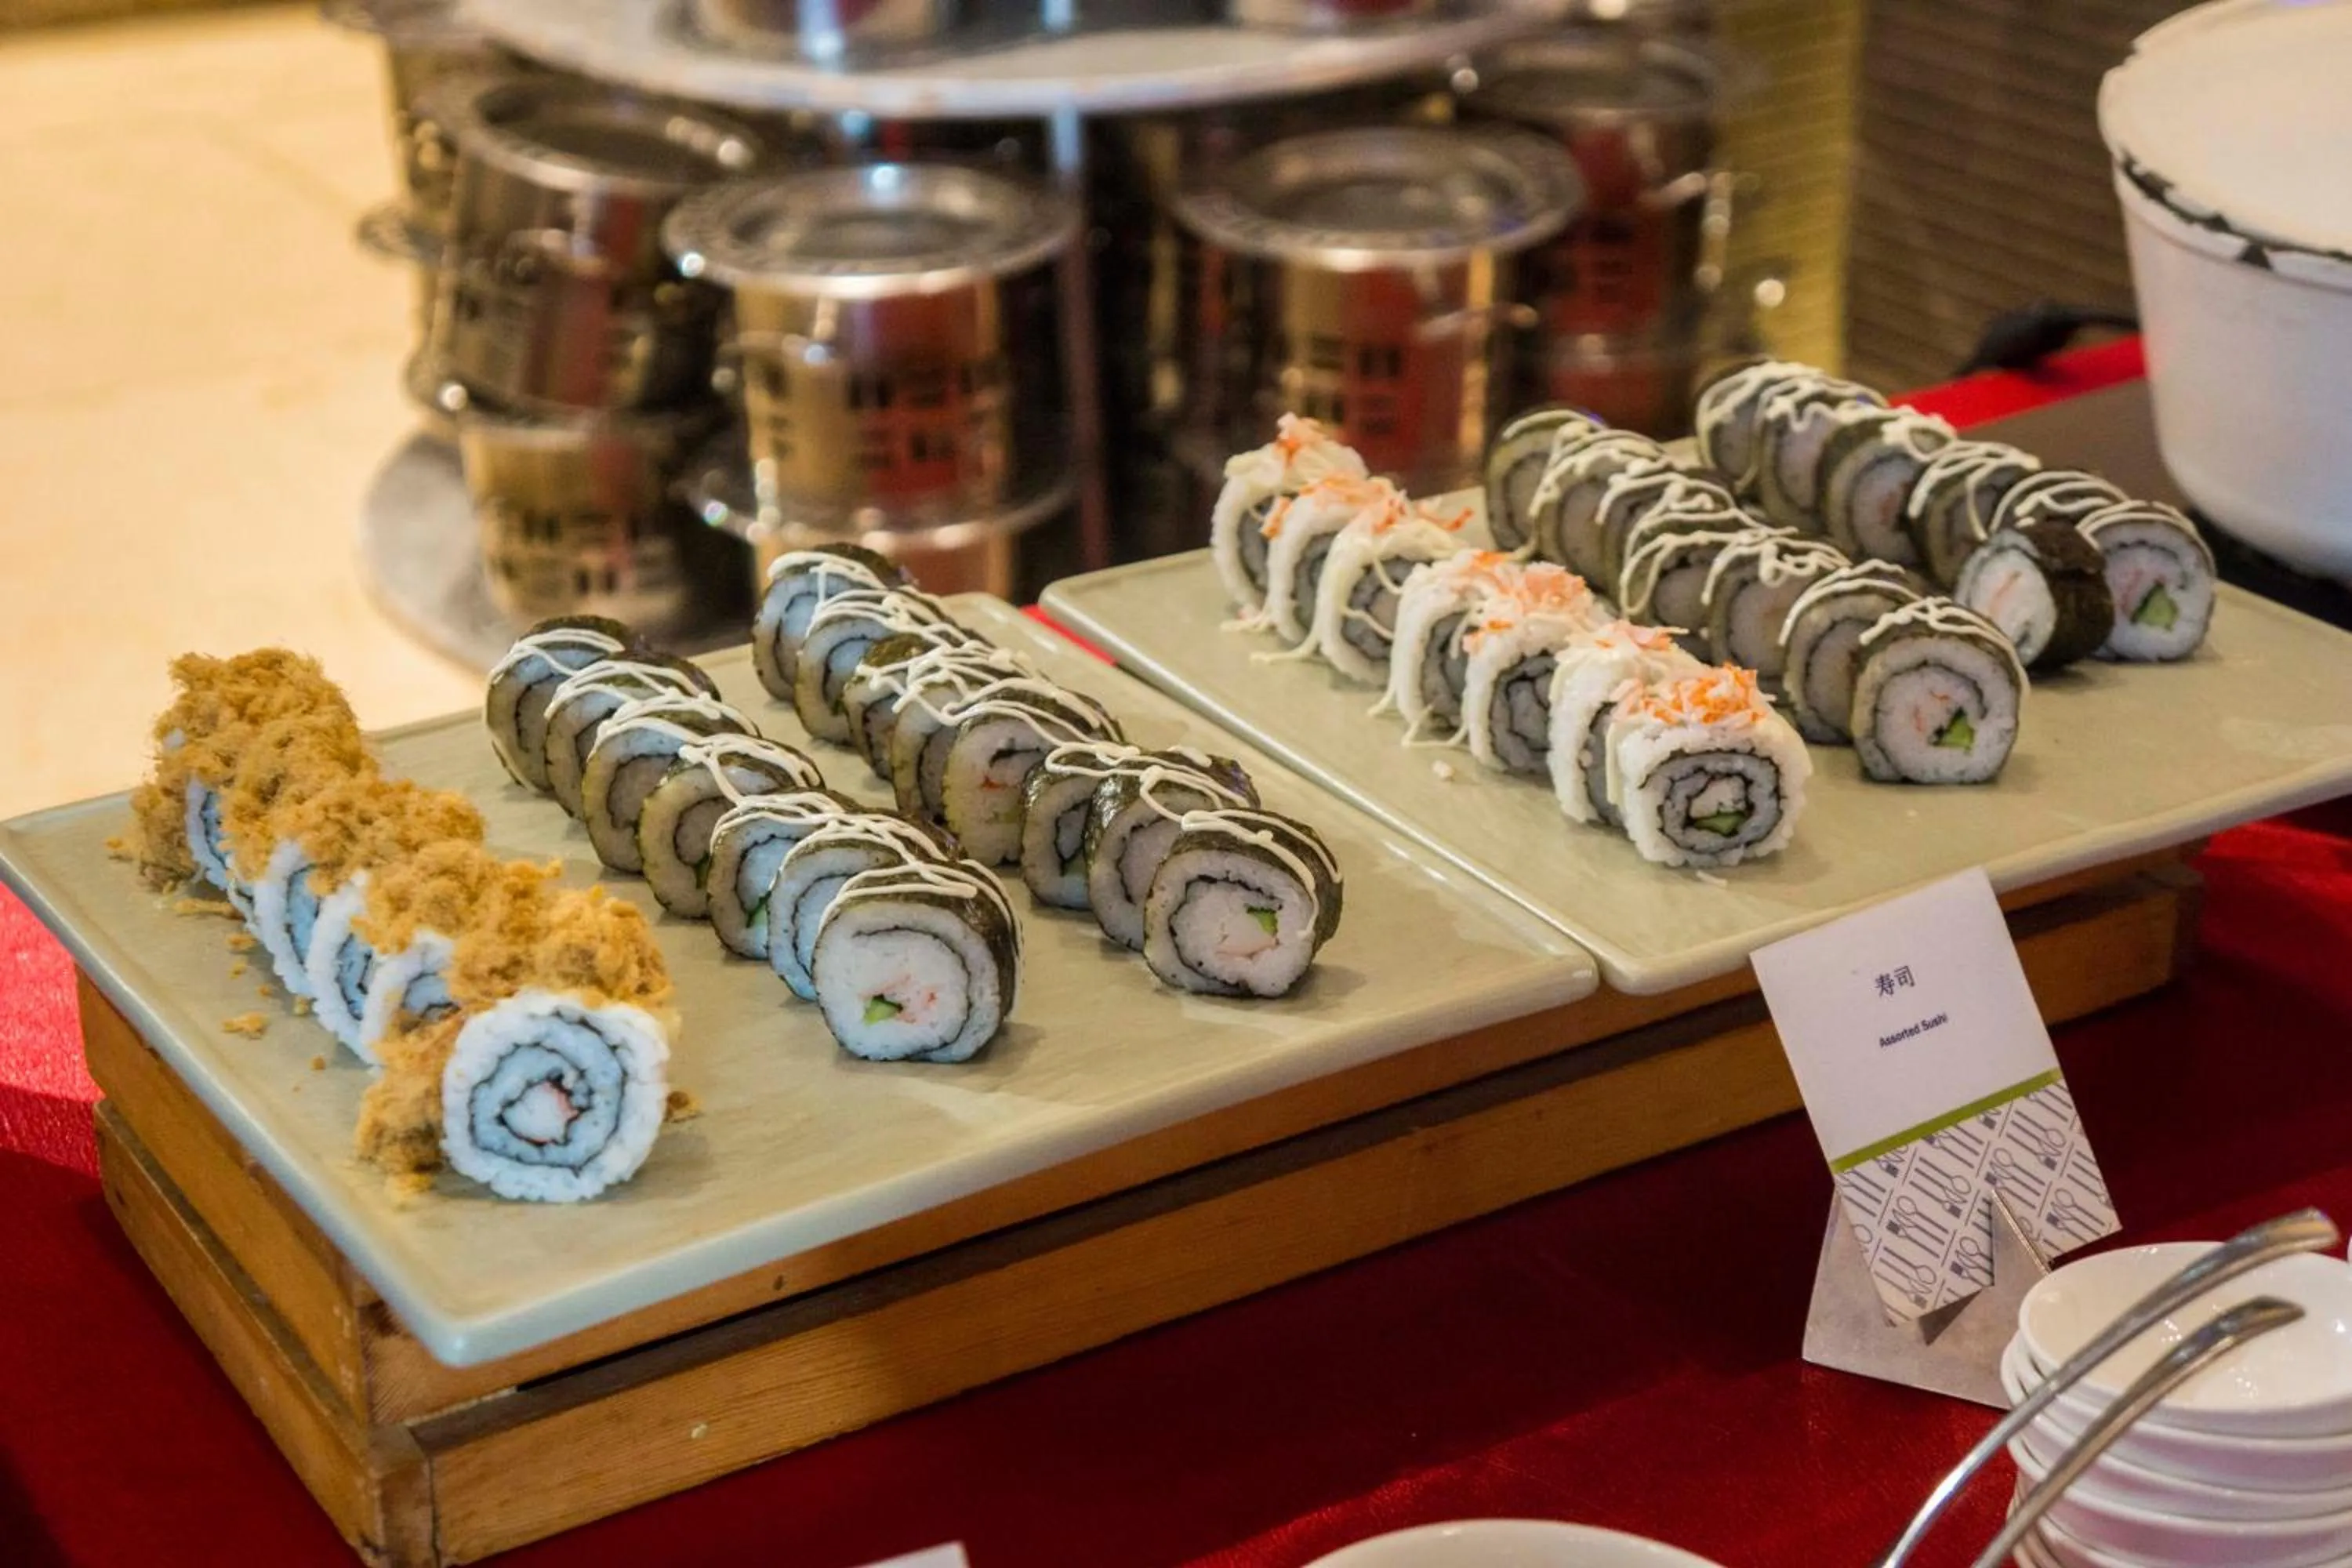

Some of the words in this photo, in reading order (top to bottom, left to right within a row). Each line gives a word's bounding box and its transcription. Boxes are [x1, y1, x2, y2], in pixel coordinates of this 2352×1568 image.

[1875, 965, 1915, 996] 寿司
[1879, 1023, 1921, 1047] Assorted
[1921, 1012, 1948, 1031] Sushi
